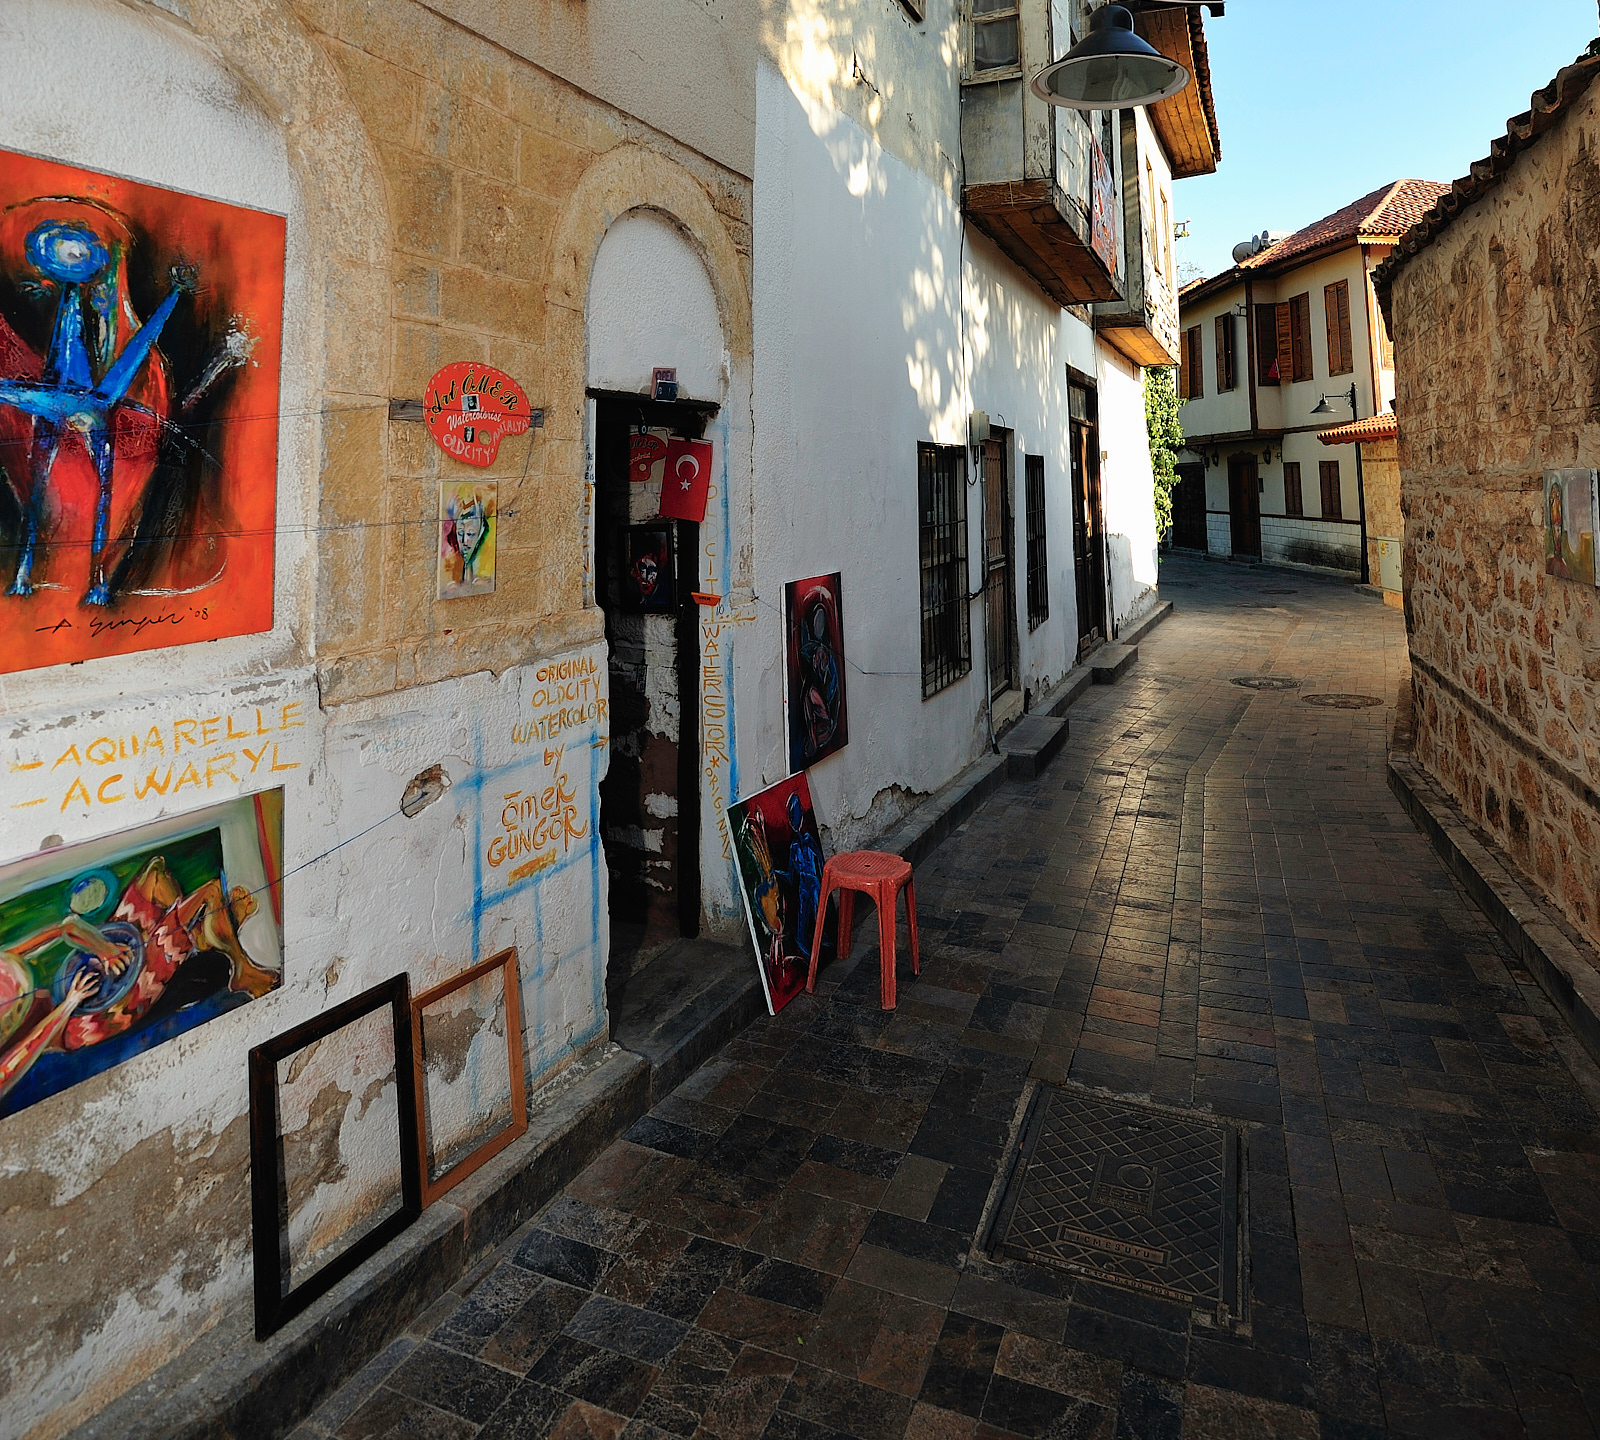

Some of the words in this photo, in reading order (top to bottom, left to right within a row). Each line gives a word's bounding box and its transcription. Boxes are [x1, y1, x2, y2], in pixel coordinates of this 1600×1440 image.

[430, 379, 459, 423] Art
[462, 369, 518, 411] ÖMER
[446, 406, 502, 431] Watercolorist
[493, 420, 528, 446] ANTALYA
[532, 671, 603, 708] OLDCITY
[537, 653, 598, 685] ORIGINAL
[702, 625, 729, 763] WATERCOLOR
[50, 701, 306, 772] AQUARELLE
[512, 698, 608, 745] WATERCOLOR
[60, 740, 302, 813] ACWARYL
[705, 767, 731, 860] ORIGINAL
